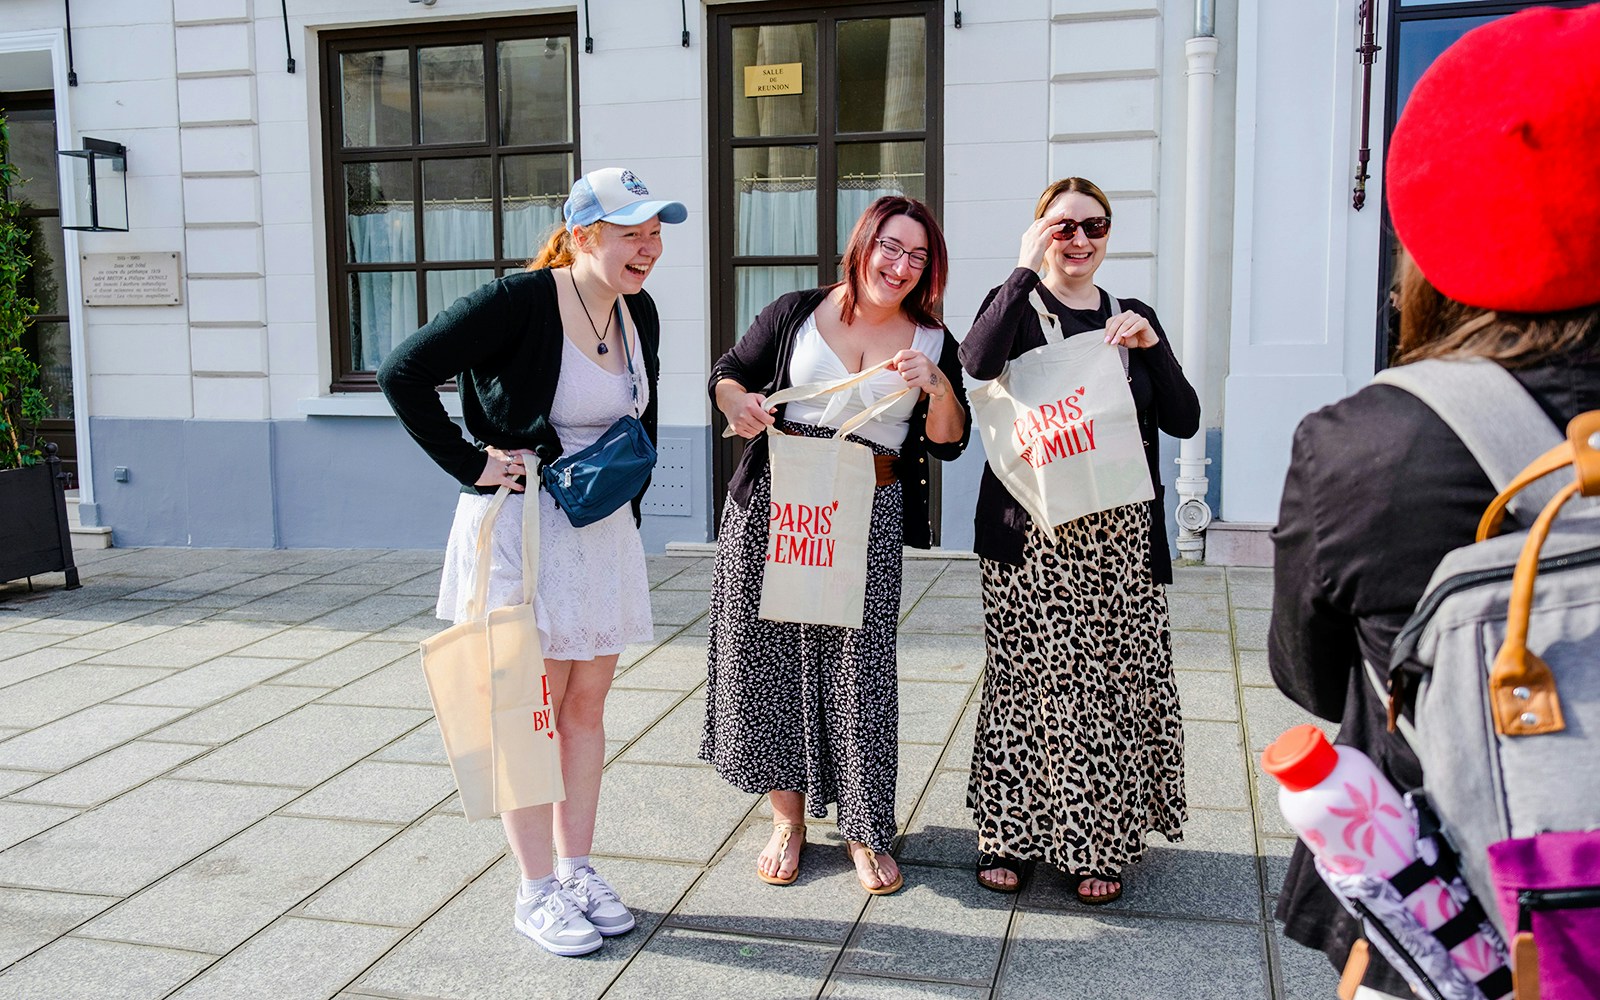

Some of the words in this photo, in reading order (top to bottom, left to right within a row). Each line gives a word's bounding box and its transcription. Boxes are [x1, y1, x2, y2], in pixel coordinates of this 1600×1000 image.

[757, 84, 790, 92] REUNION
[1014, 396, 1083, 446] PARIS
[774, 534, 836, 567] EMILY
[533, 709, 551, 731] BY
